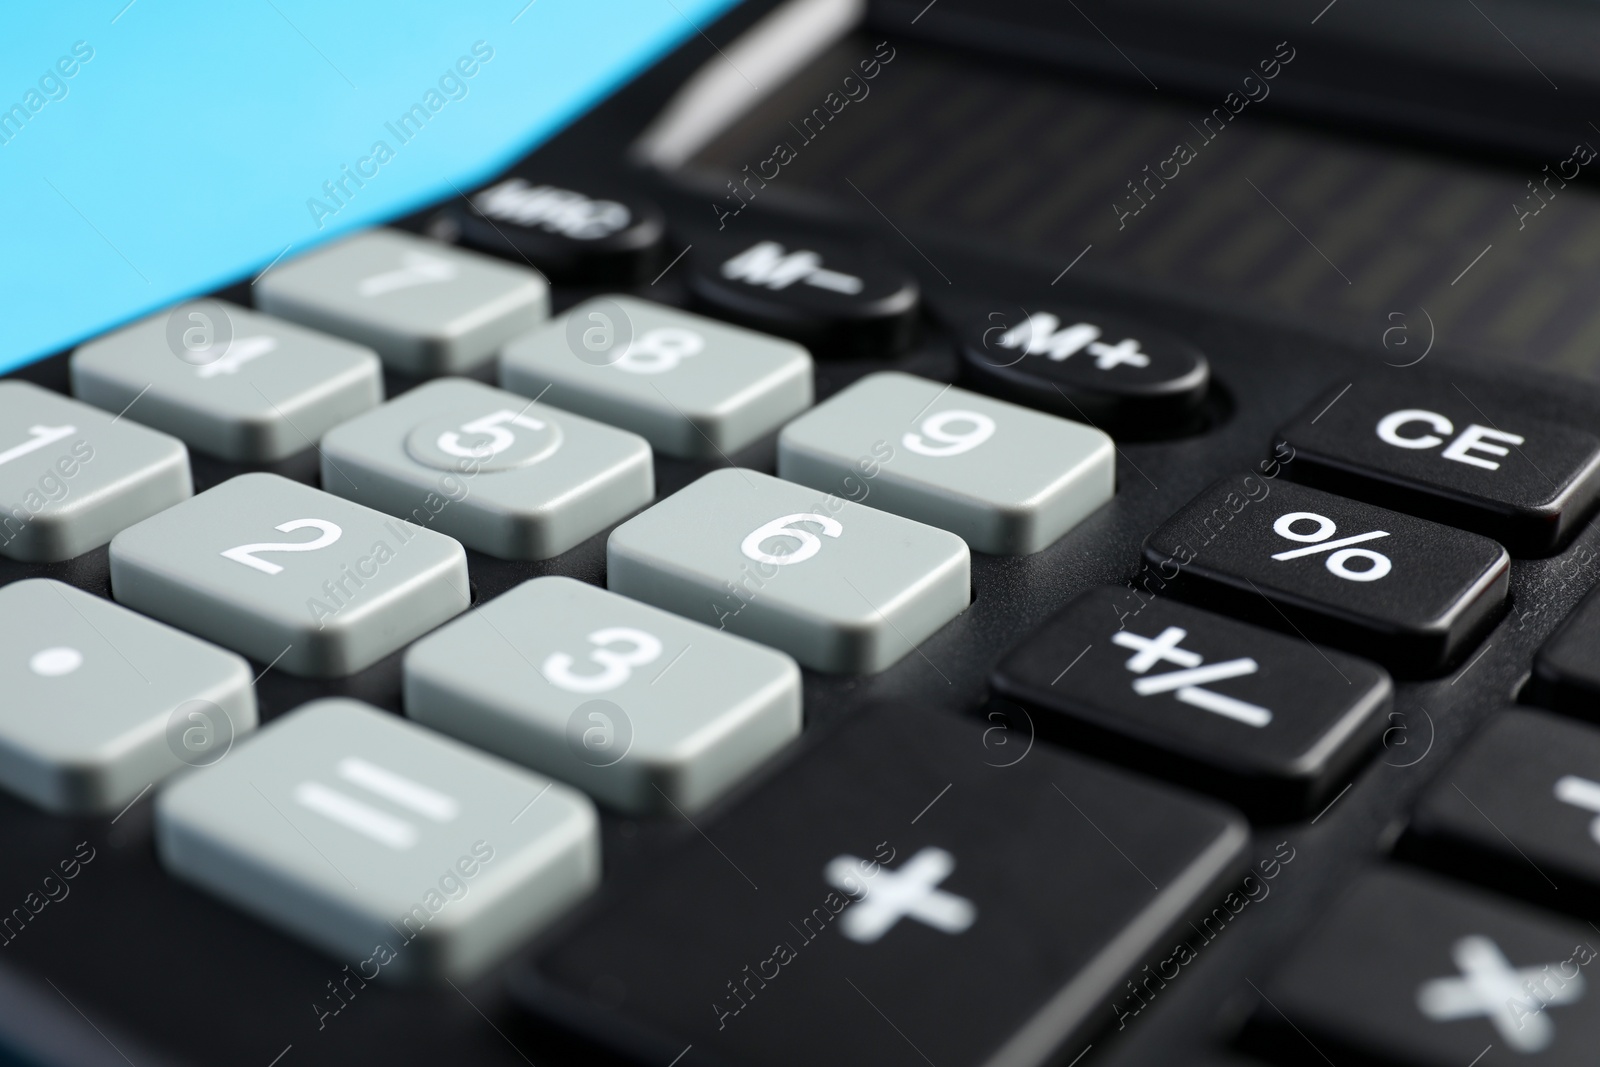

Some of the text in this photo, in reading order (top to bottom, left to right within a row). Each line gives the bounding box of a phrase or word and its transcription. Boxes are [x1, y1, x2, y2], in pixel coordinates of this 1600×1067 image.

[608, 327, 705, 374] 8
[0, 424, 78, 465] 1
[437, 409, 547, 458] 5
[903, 409, 996, 457] 9
[1376, 409, 1524, 471] CE
[220, 518, 343, 575] 2
[741, 512, 844, 566] 6
[1272, 512, 1392, 582] %
[543, 627, 662, 694] 3
[824, 846, 977, 944] +
